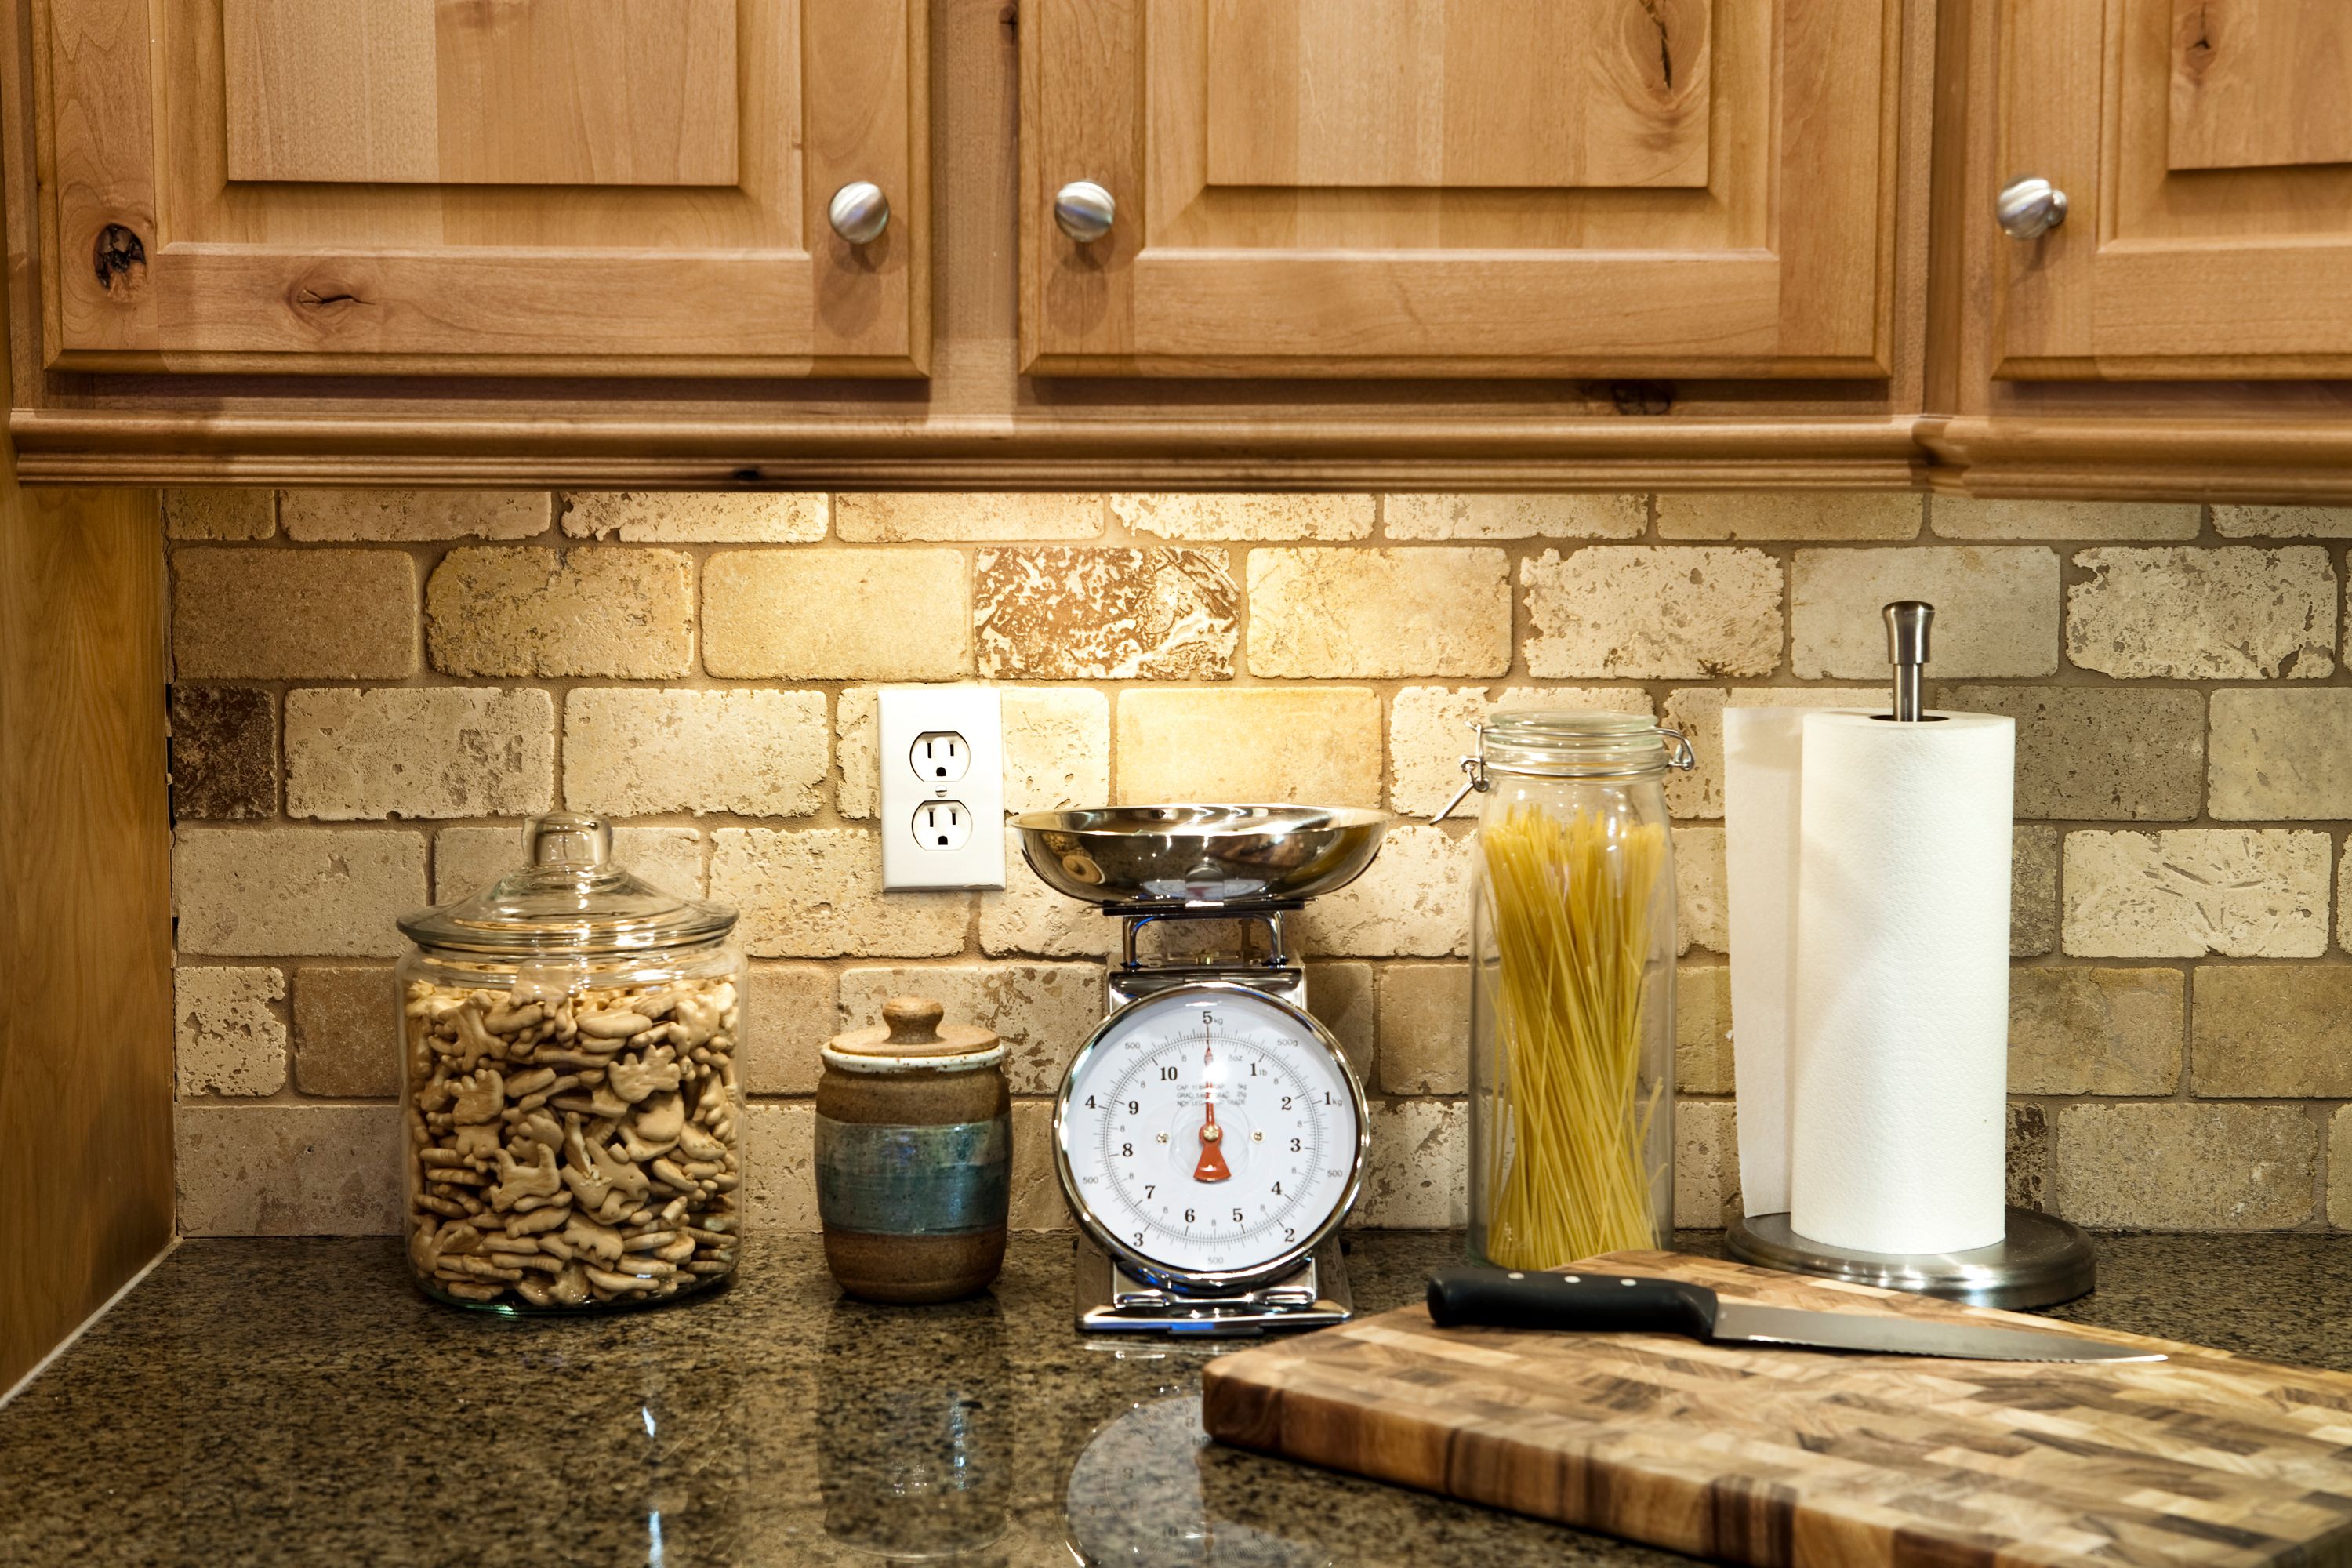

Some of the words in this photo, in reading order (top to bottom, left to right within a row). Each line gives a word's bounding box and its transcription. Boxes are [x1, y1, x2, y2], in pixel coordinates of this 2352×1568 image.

[1277, 1039, 1298, 1047] 500g
[1160, 1066, 1178, 1081] 10
[1085, 1094, 1097, 1109] 4
[1128, 1100, 1139, 1115] 9
[1281, 1096, 1292, 1111] 2
[1122, 1142, 1134, 1157] 8
[1290, 1138, 1301, 1152] 3
[1145, 1185, 1156, 1200] 7
[1271, 1181, 1283, 1196] 4
[1185, 1208, 1196, 1223] 6
[1232, 1207, 1243, 1223] 5
[1134, 1232, 1144, 1247] 3
[1284, 1228, 1295, 1243] 2
